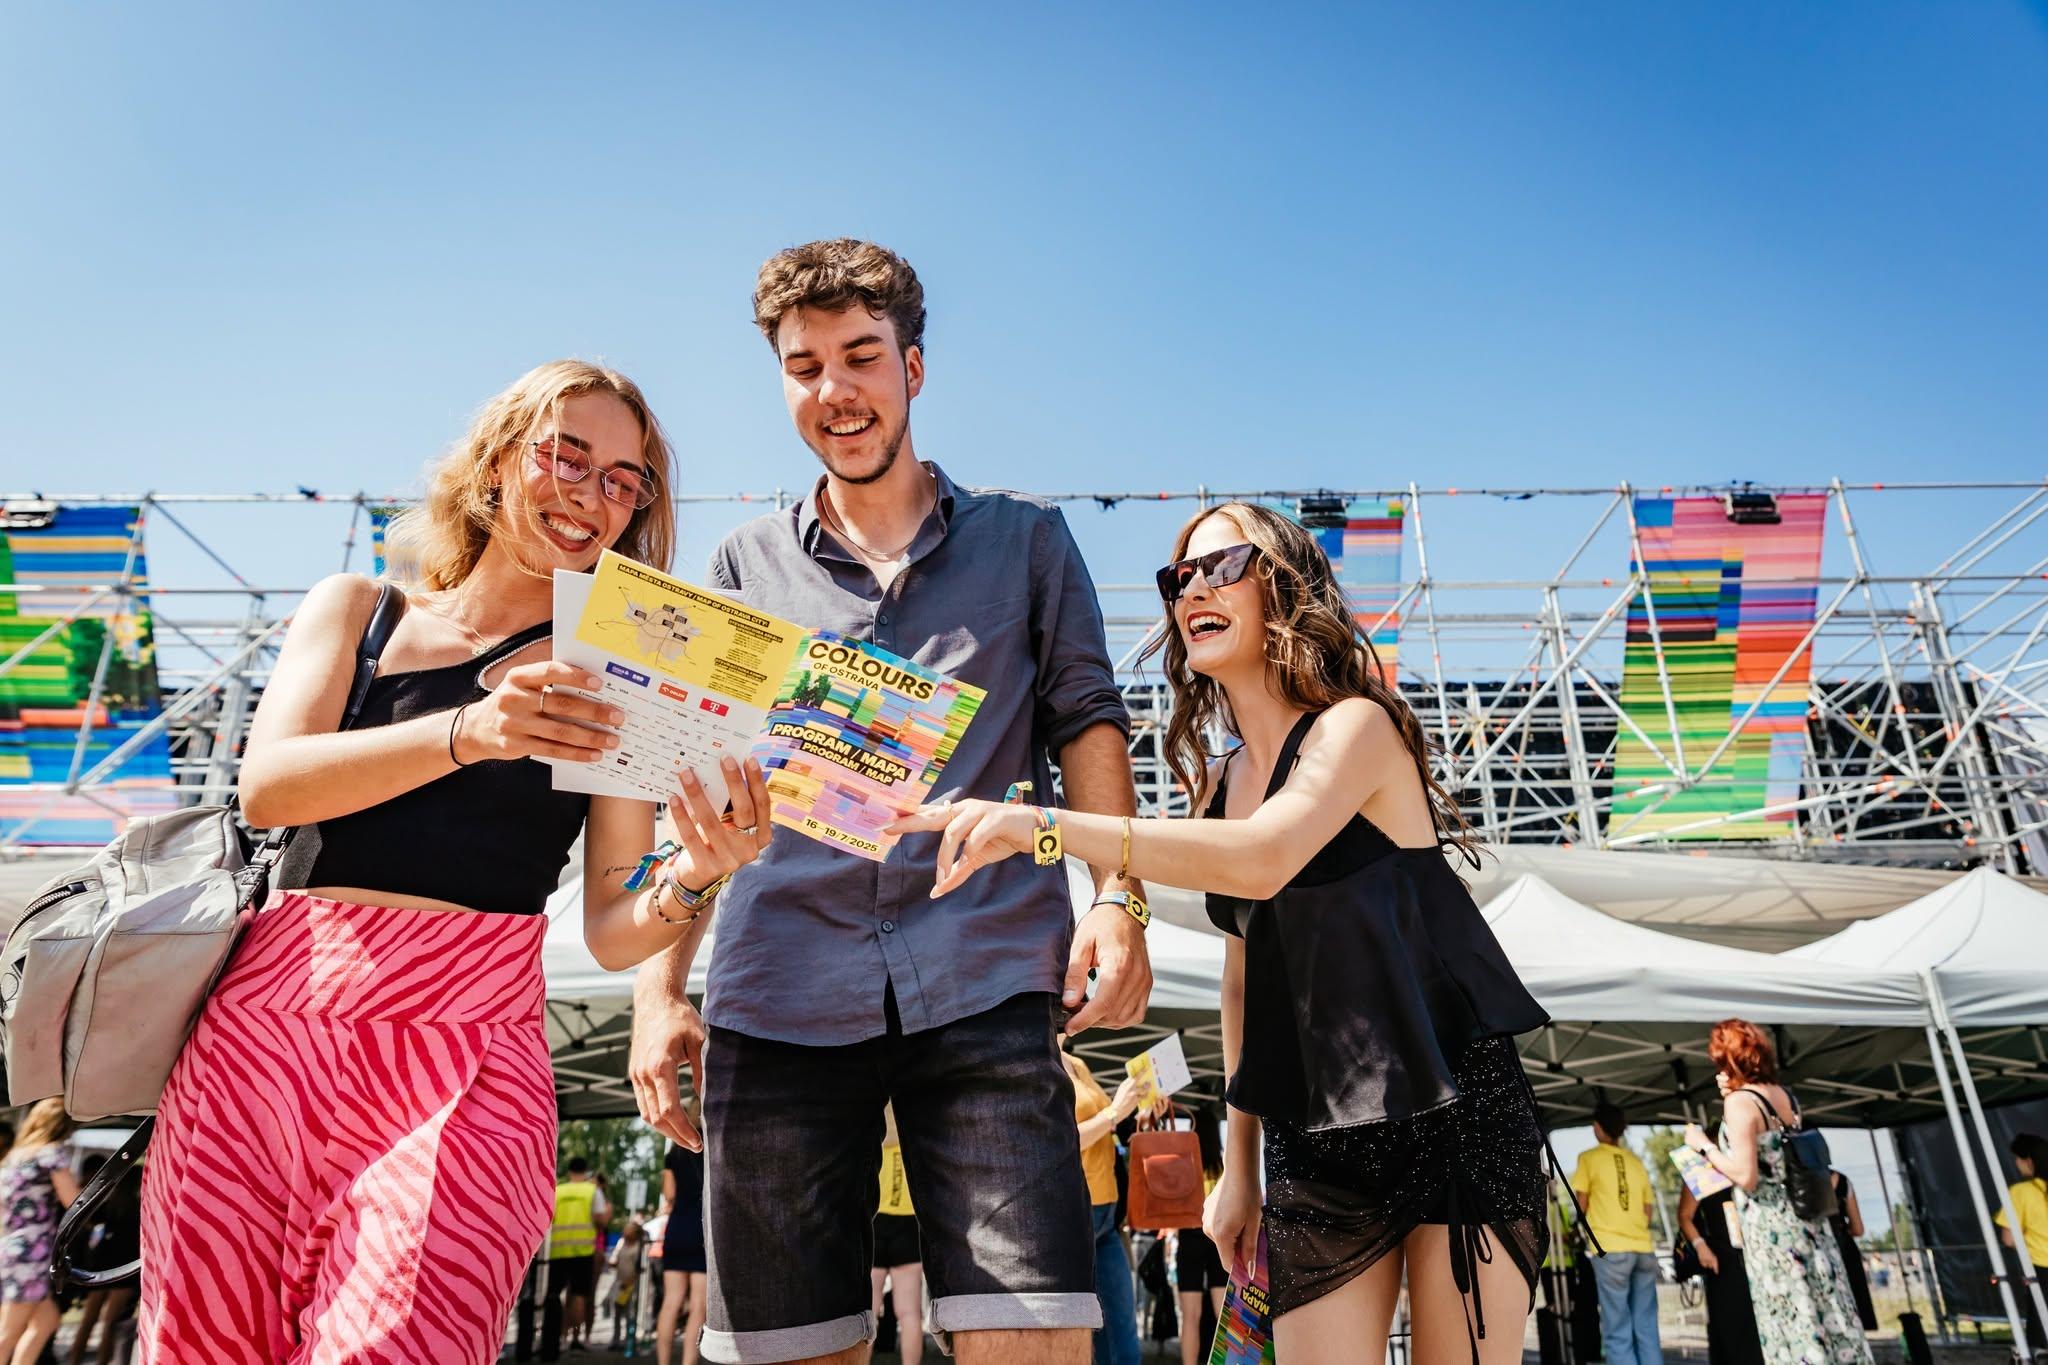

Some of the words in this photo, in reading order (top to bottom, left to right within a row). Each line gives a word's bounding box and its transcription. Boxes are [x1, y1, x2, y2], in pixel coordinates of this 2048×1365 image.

[619, 565, 639, 577] MAPA
[661, 583, 693, 598] OSTRAVY
[696, 596, 713, 608] MAP
[712, 601, 722, 610] OF
[720, 605, 751, 620] OSTRAVA
[809, 643, 933, 699] COLOURS
[813, 662, 829, 671] OF
[829, 666, 879, 691] OSTRAVA
[771, 724, 853, 756] PROGRAM
[850, 748, 862, 760] /
[860, 753, 906, 779] MAPA
[802, 742, 859, 771] PROGRAM
[857, 765, 867, 774] /
[865, 768, 893, 784] MAP
[1038, 835, 1057, 854] C
[1242, 1289, 1270, 1316] MAPA
[1248, 1286, 1266, 1301] MAP
